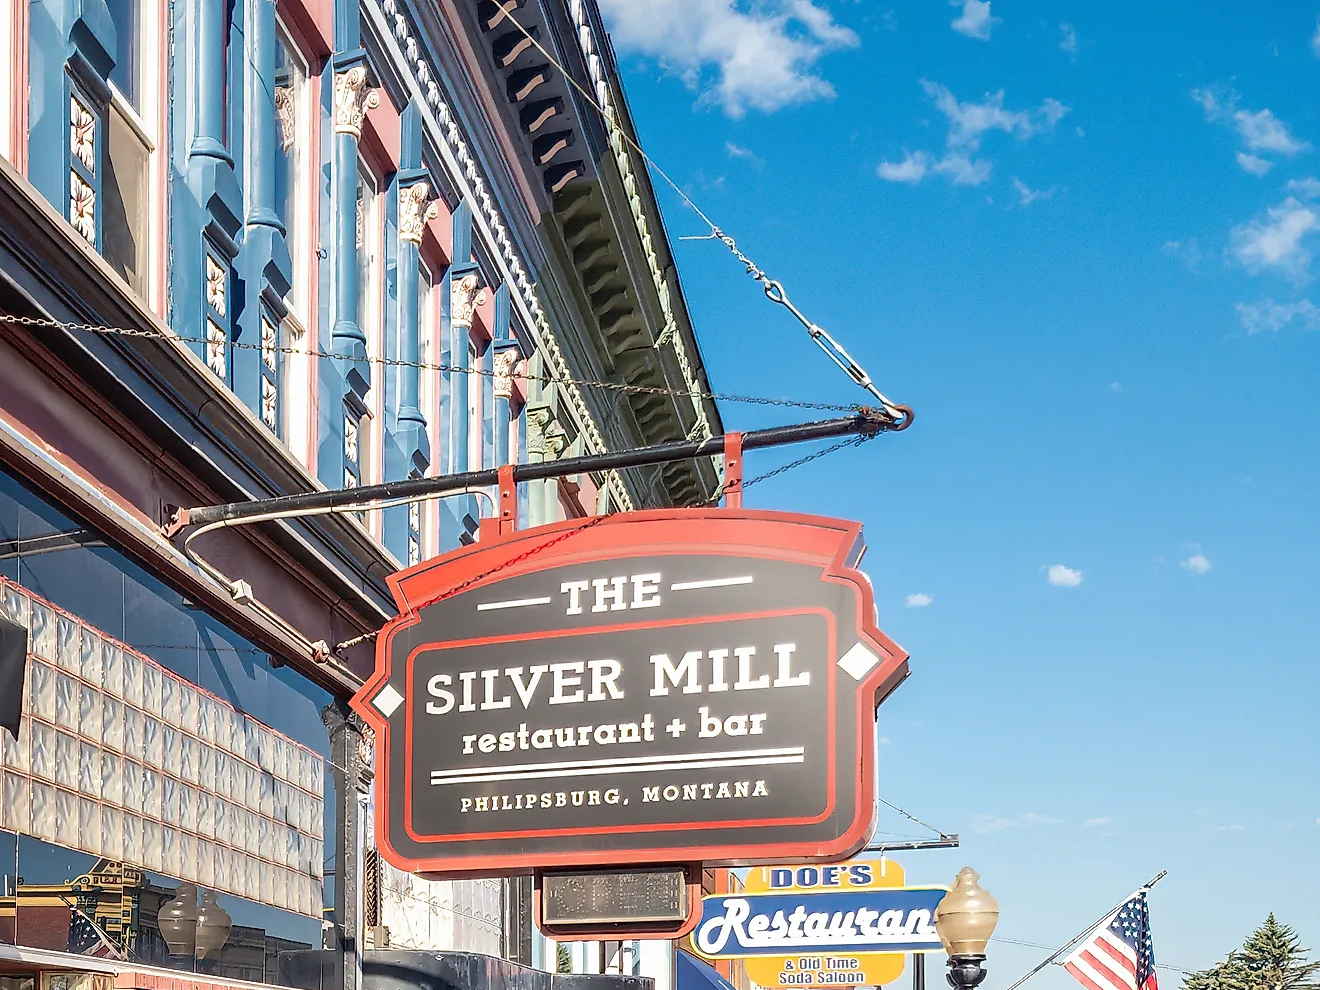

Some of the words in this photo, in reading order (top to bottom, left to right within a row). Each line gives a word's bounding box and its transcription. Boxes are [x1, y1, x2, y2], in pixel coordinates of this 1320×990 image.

[561, 572, 661, 616] THE
[425, 658, 625, 716] SILVER
[649, 642, 810, 698] MILL
[462, 713, 656, 756] restaurant
[697, 706, 767, 740] bar
[460, 787, 629, 814] PHILIPSBURG,
[641, 779, 769, 804] MONTANA
[769, 864, 873, 889] DOE'S
[697, 897, 942, 954] Restauran
[779, 971, 813, 984] Soda
[817, 971, 864, 984] Saloon
[785, 960, 794, 970] &
[799, 958, 820, 970] Old
[825, 957, 858, 969] Time
